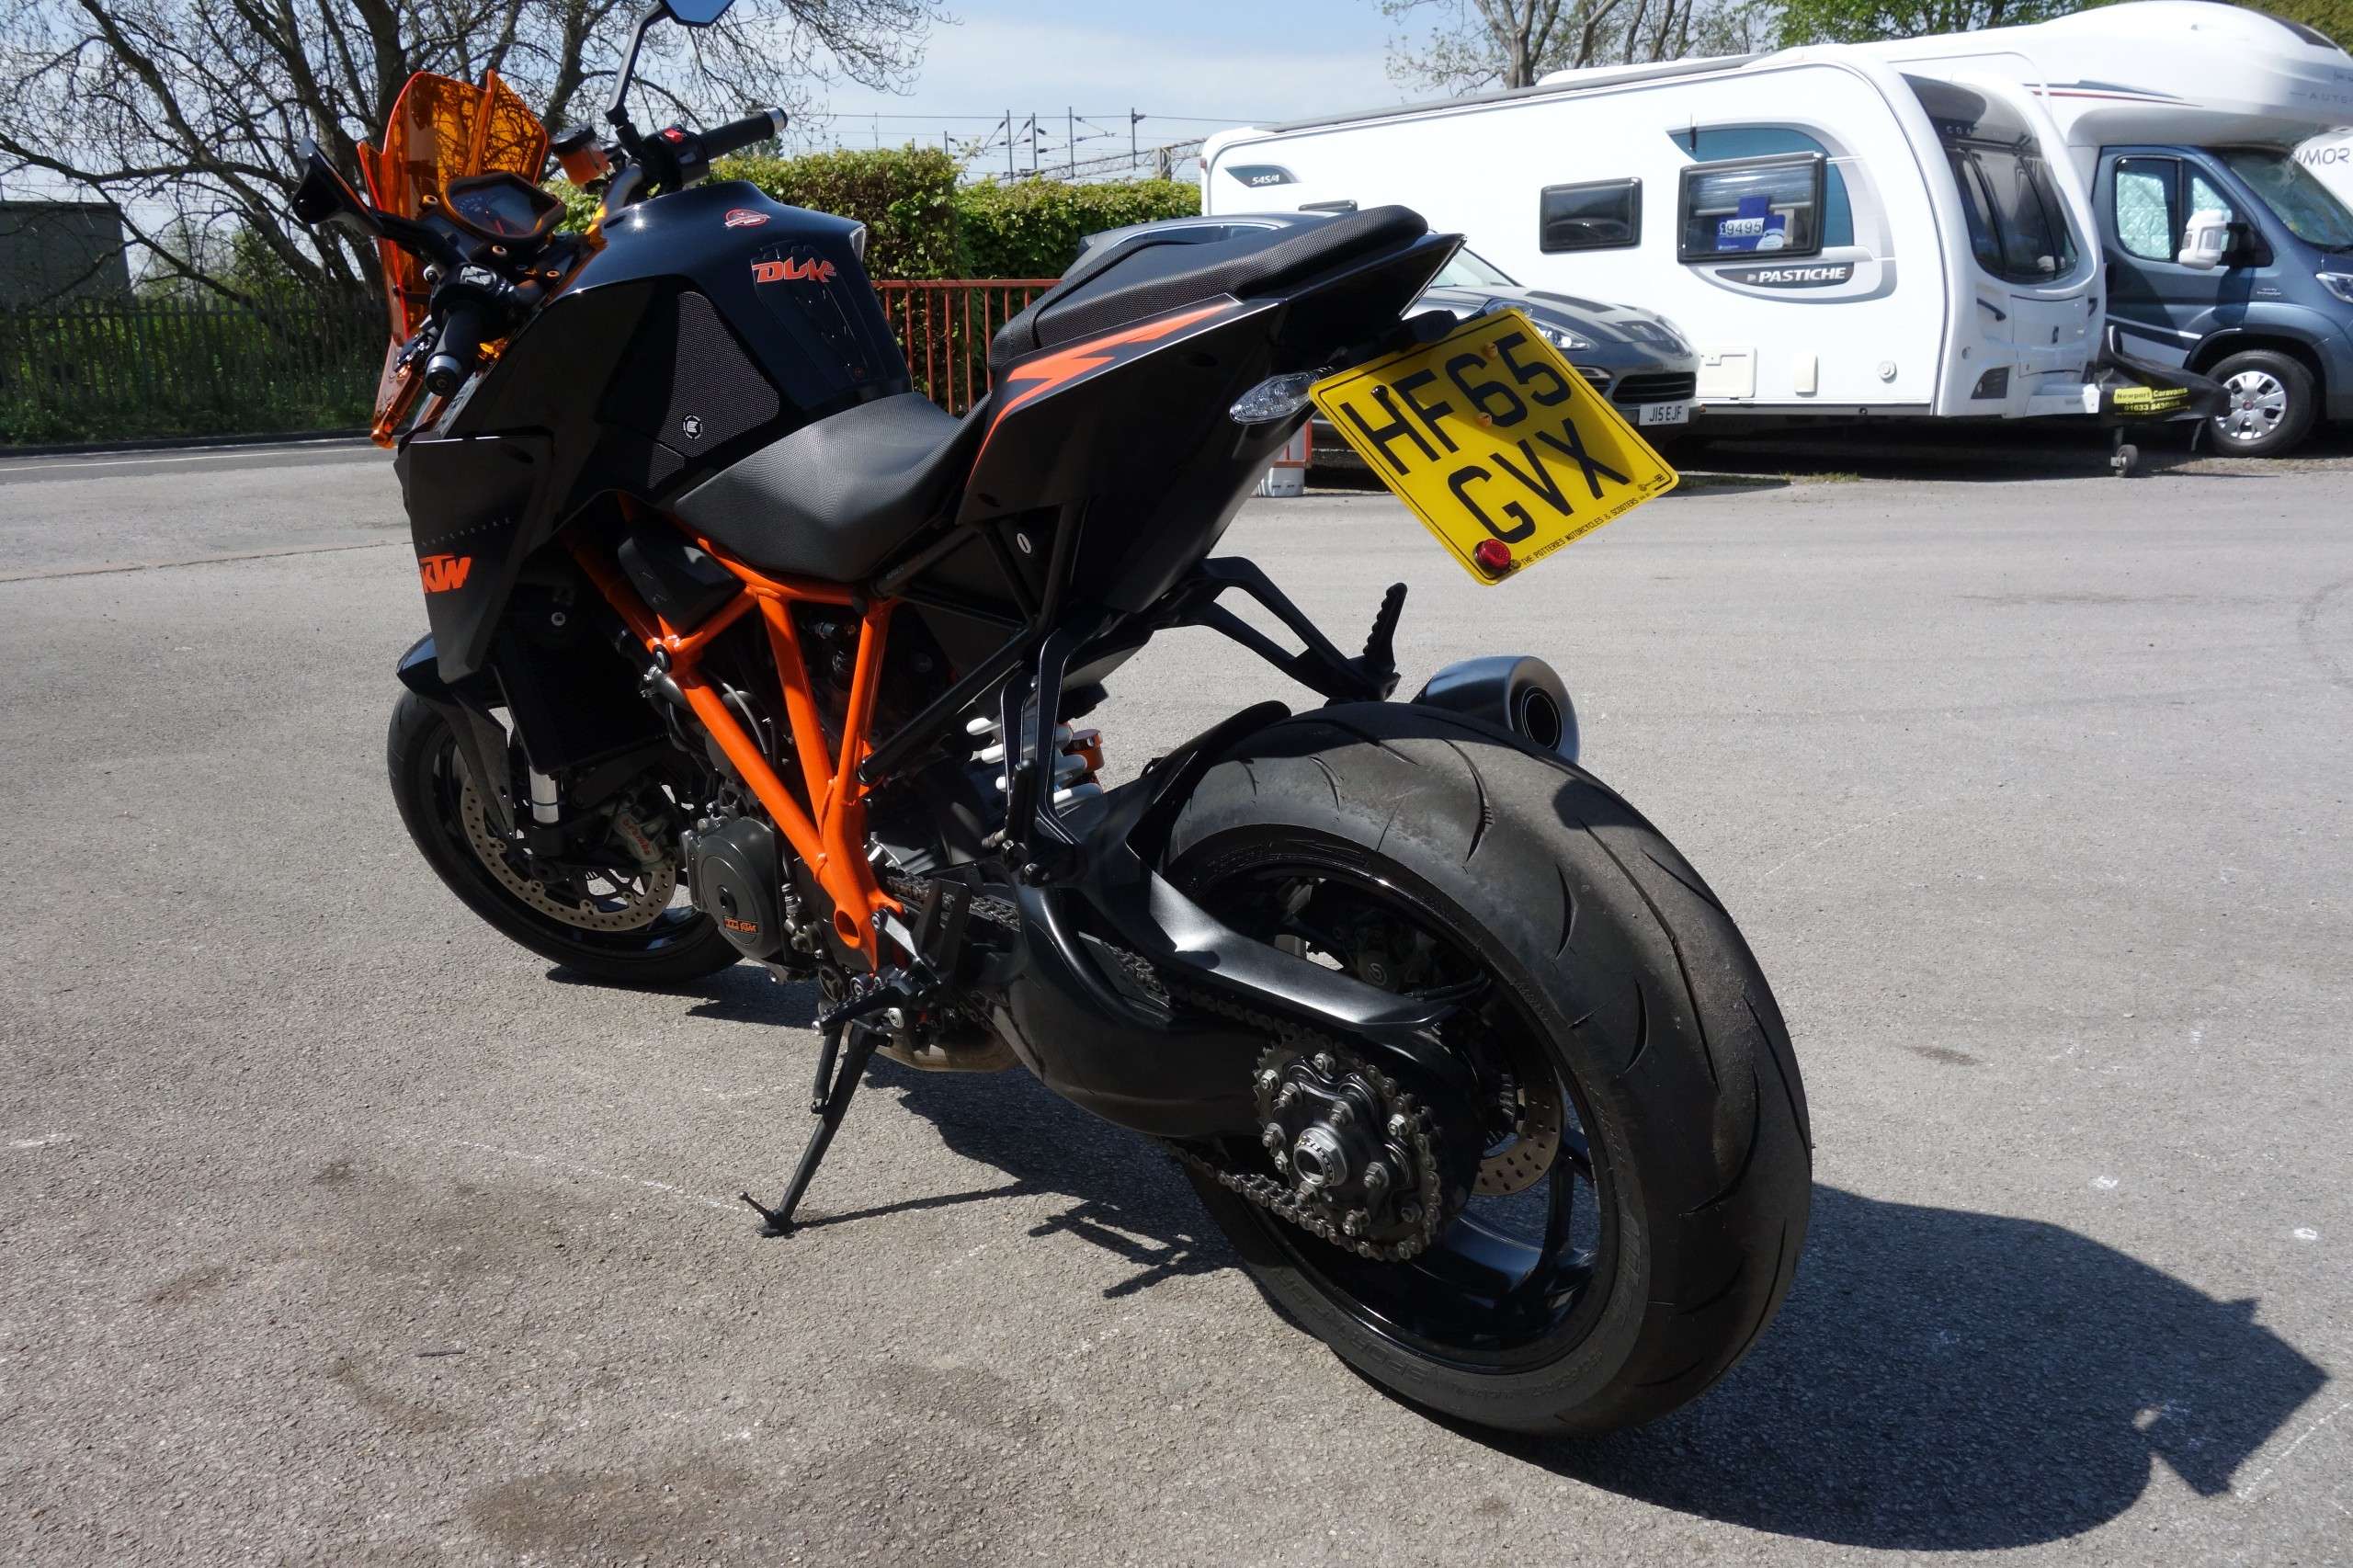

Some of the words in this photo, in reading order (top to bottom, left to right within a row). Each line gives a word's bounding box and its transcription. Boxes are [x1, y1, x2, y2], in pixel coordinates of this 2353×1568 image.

[1759, 267, 1846, 282] PASTICHE
[1339, 331, 1572, 475] HF65
[1665, 405, 1682, 420] EJF
[1448, 418, 1631, 544] GVX
[1521, 554, 1535, 565] THE
[1534, 538, 1565, 558] POTTERIES
[1565, 517, 1604, 540] MOTORCYCLES
[1610, 497, 1639, 516] SCOOTERS
[419, 555, 472, 594] KTM
